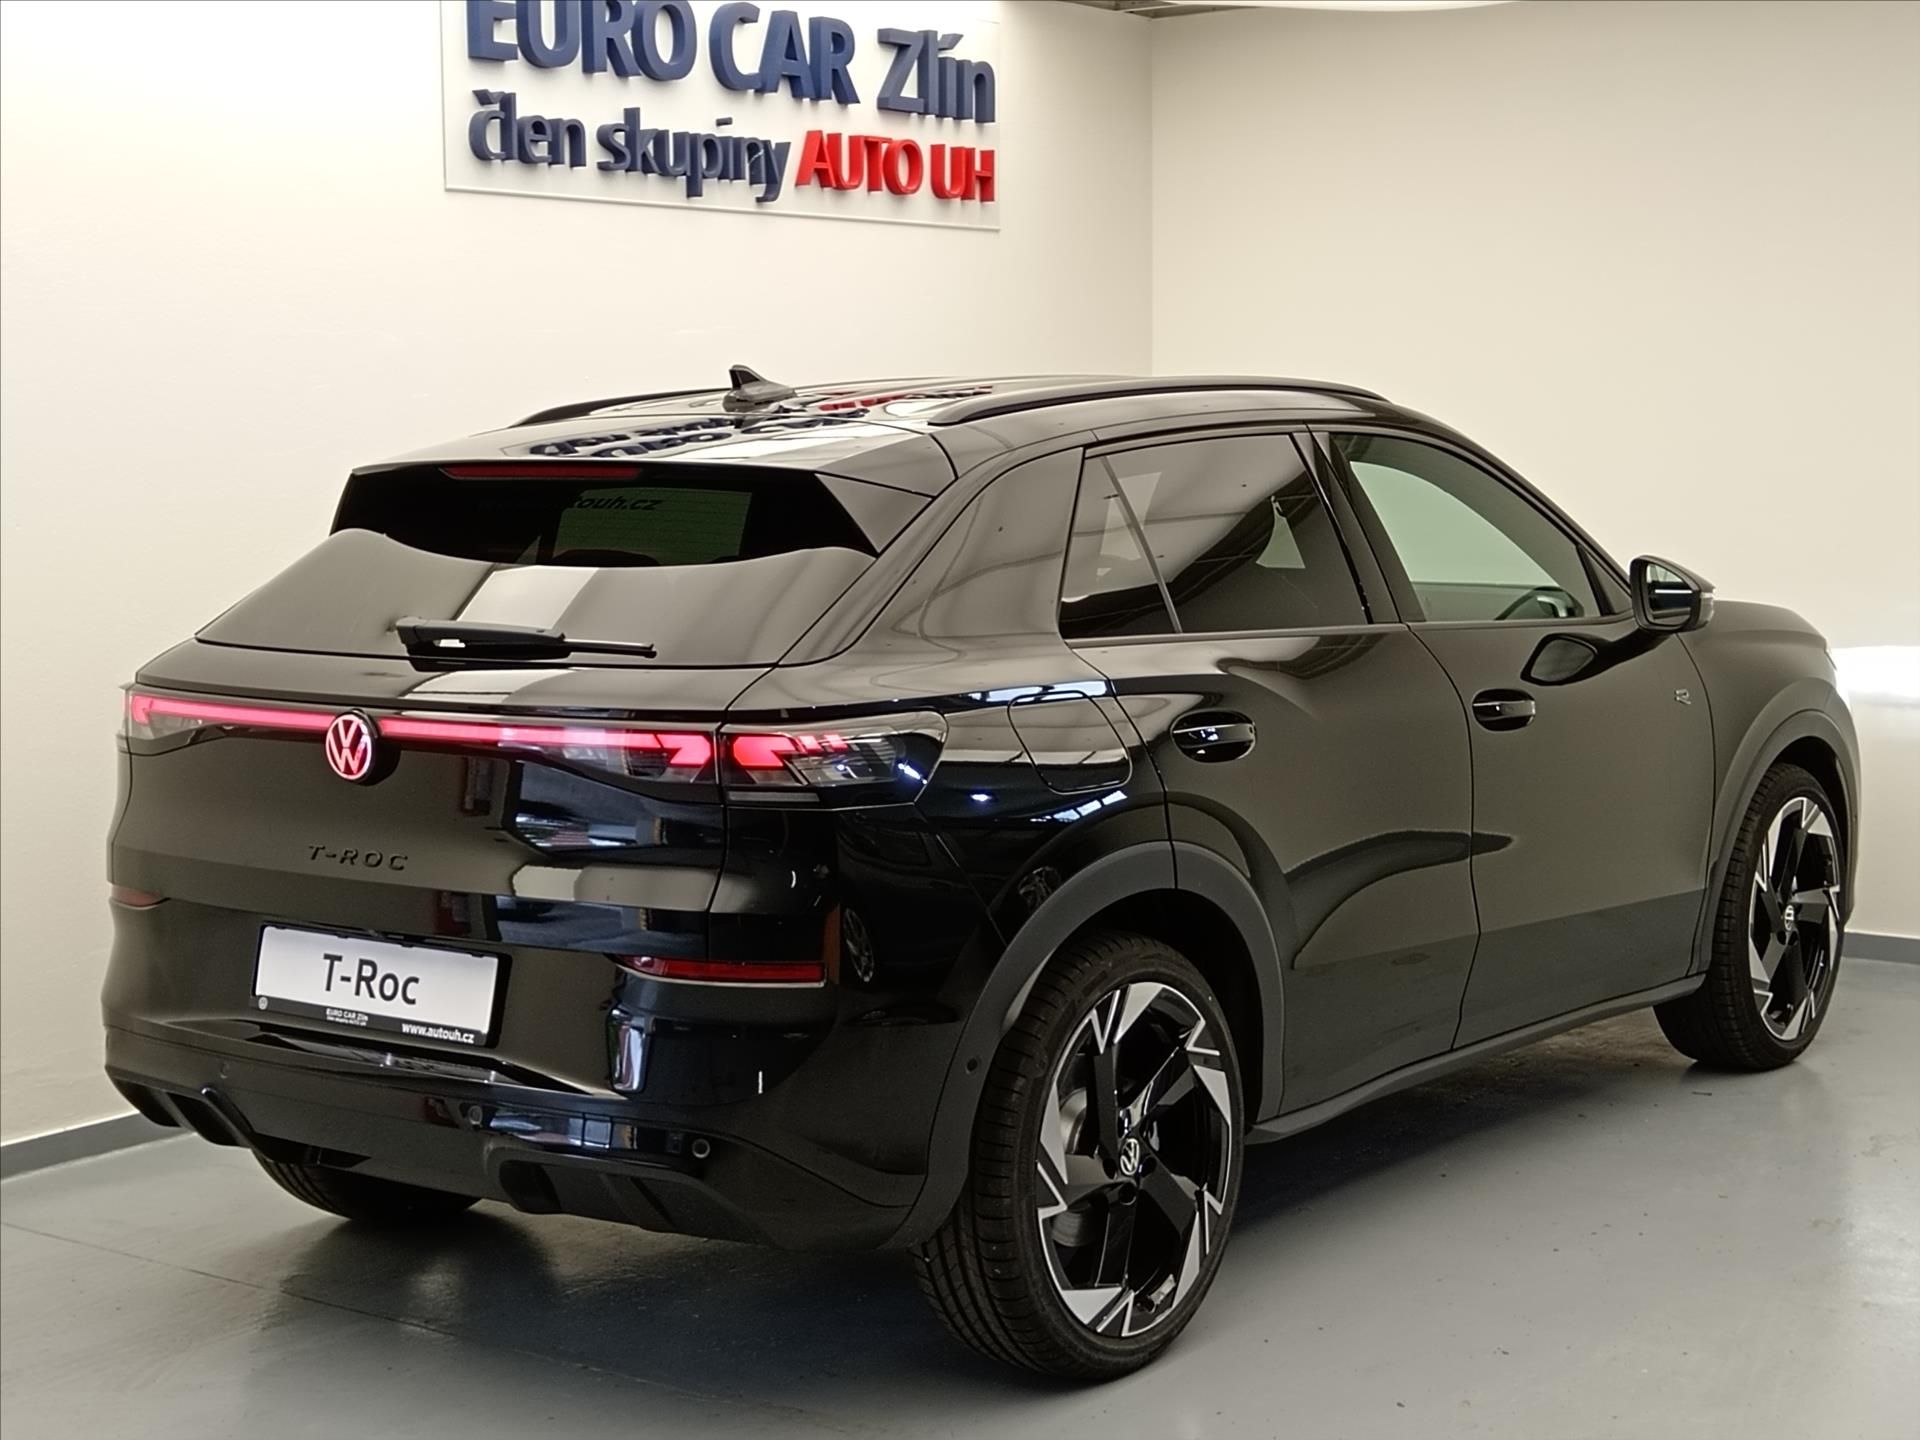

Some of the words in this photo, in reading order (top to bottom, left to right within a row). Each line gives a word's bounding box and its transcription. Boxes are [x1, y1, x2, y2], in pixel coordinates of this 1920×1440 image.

[467, 0, 698, 82] EURO
[709, 1, 861, 105] CAR
[877, 28, 996, 124] Zlín
[469, 89, 588, 168] člen
[596, 107, 792, 203] skupiny
[794, 130, 923, 196] AUTO
[930, 143, 996, 202] UH
[308, 844, 409, 872] T-ROC
[323, 953, 420, 1005] T-Roc
[402, 1023, 475, 1044] www.autouh.cz
